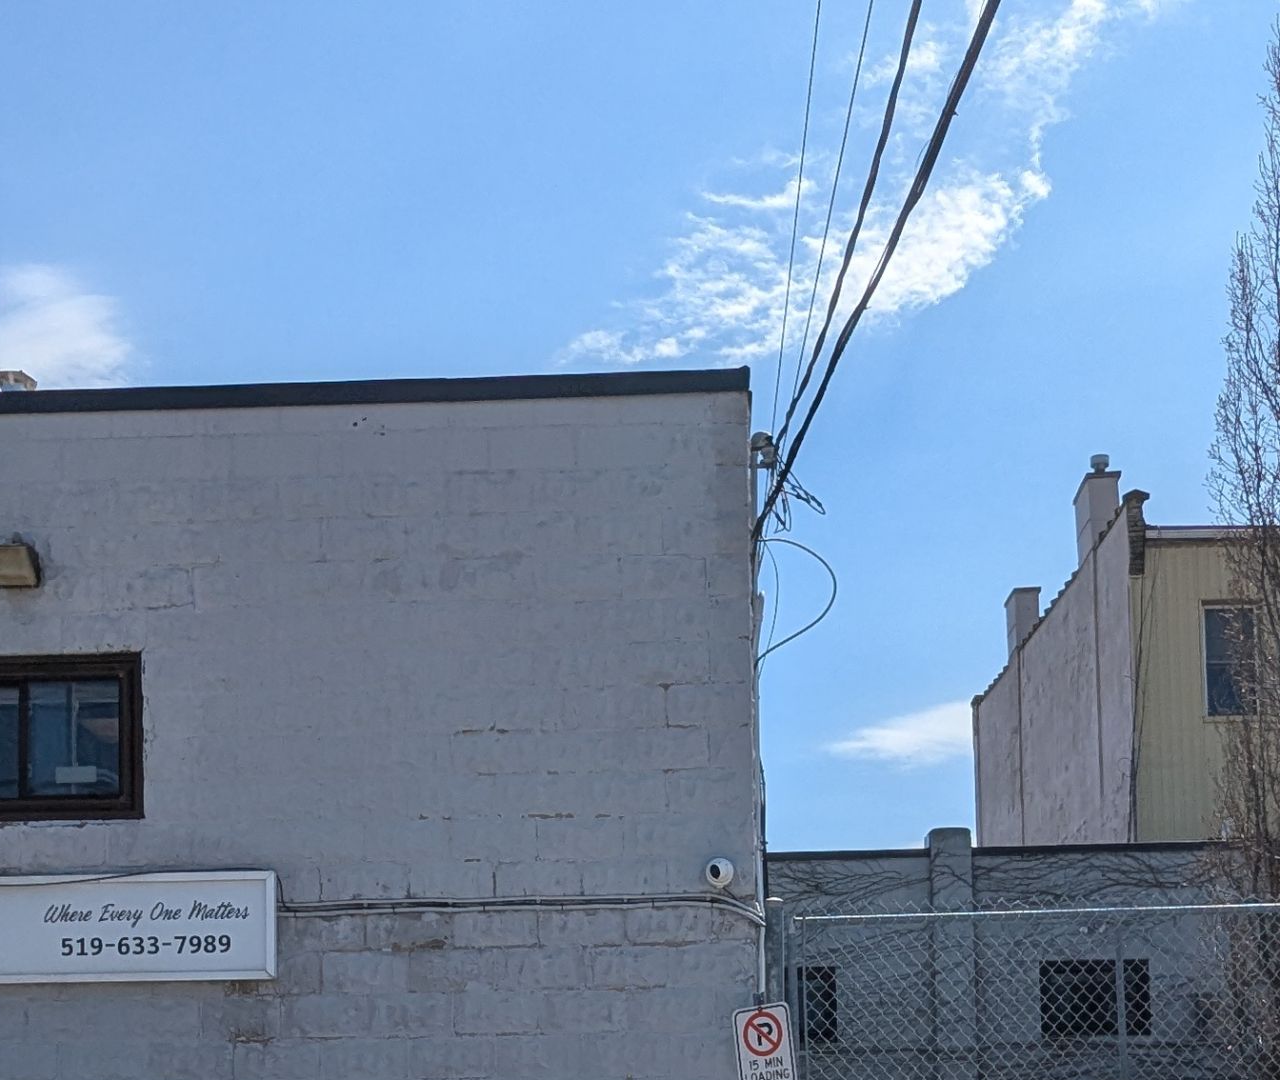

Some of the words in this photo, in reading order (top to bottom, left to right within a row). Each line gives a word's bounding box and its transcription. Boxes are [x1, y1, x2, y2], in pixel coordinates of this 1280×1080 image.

[43, 903, 93, 924] Where
[98, 903, 143, 928] Every
[149, 901, 182, 921] One
[187, 899, 250, 920] Matters
[61, 934, 232, 956] 519-633-7989
[748, 1059, 759, 1071] 15
[764, 1056, 784, 1069] MIN
